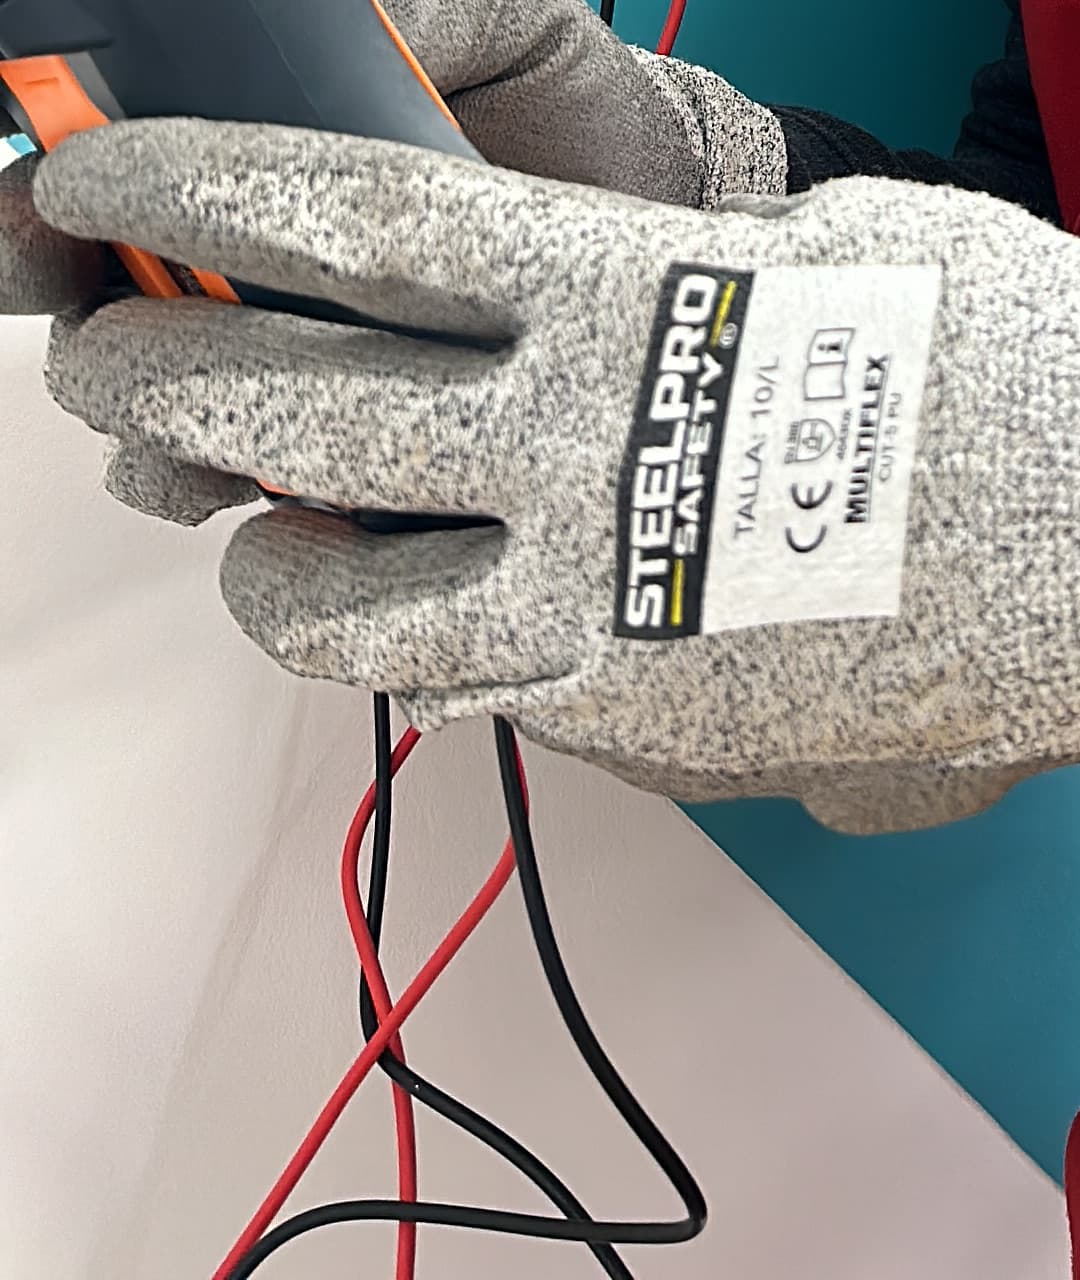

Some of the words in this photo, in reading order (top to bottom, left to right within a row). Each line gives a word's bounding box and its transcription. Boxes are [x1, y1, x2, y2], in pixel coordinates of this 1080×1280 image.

[626, 273, 718, 628] STEELPRO
[673, 352, 723, 557] SAFETY
[735, 433, 767, 538] TALLA:
[751, 354, 780, 419] 10/L
[843, 352, 889, 524] MULTIFLEX
